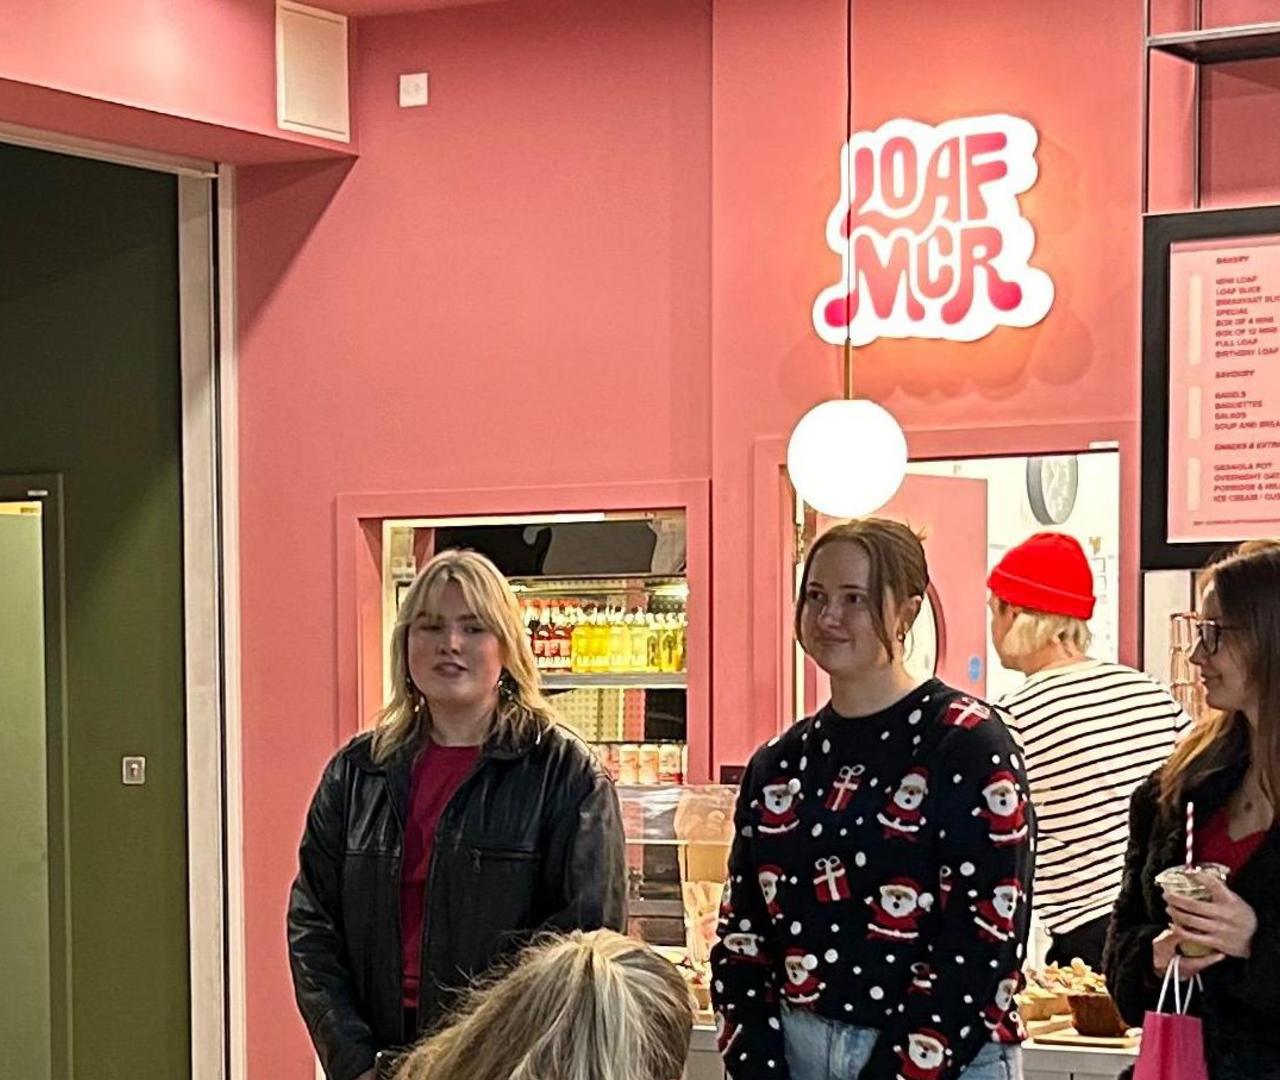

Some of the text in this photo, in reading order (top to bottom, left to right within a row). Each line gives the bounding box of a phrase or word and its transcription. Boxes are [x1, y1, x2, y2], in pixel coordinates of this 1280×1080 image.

[840, 132, 1008, 239] LOAF
[824, 226, 1022, 327] MCR
[1238, 421, 1257, 429] AND
